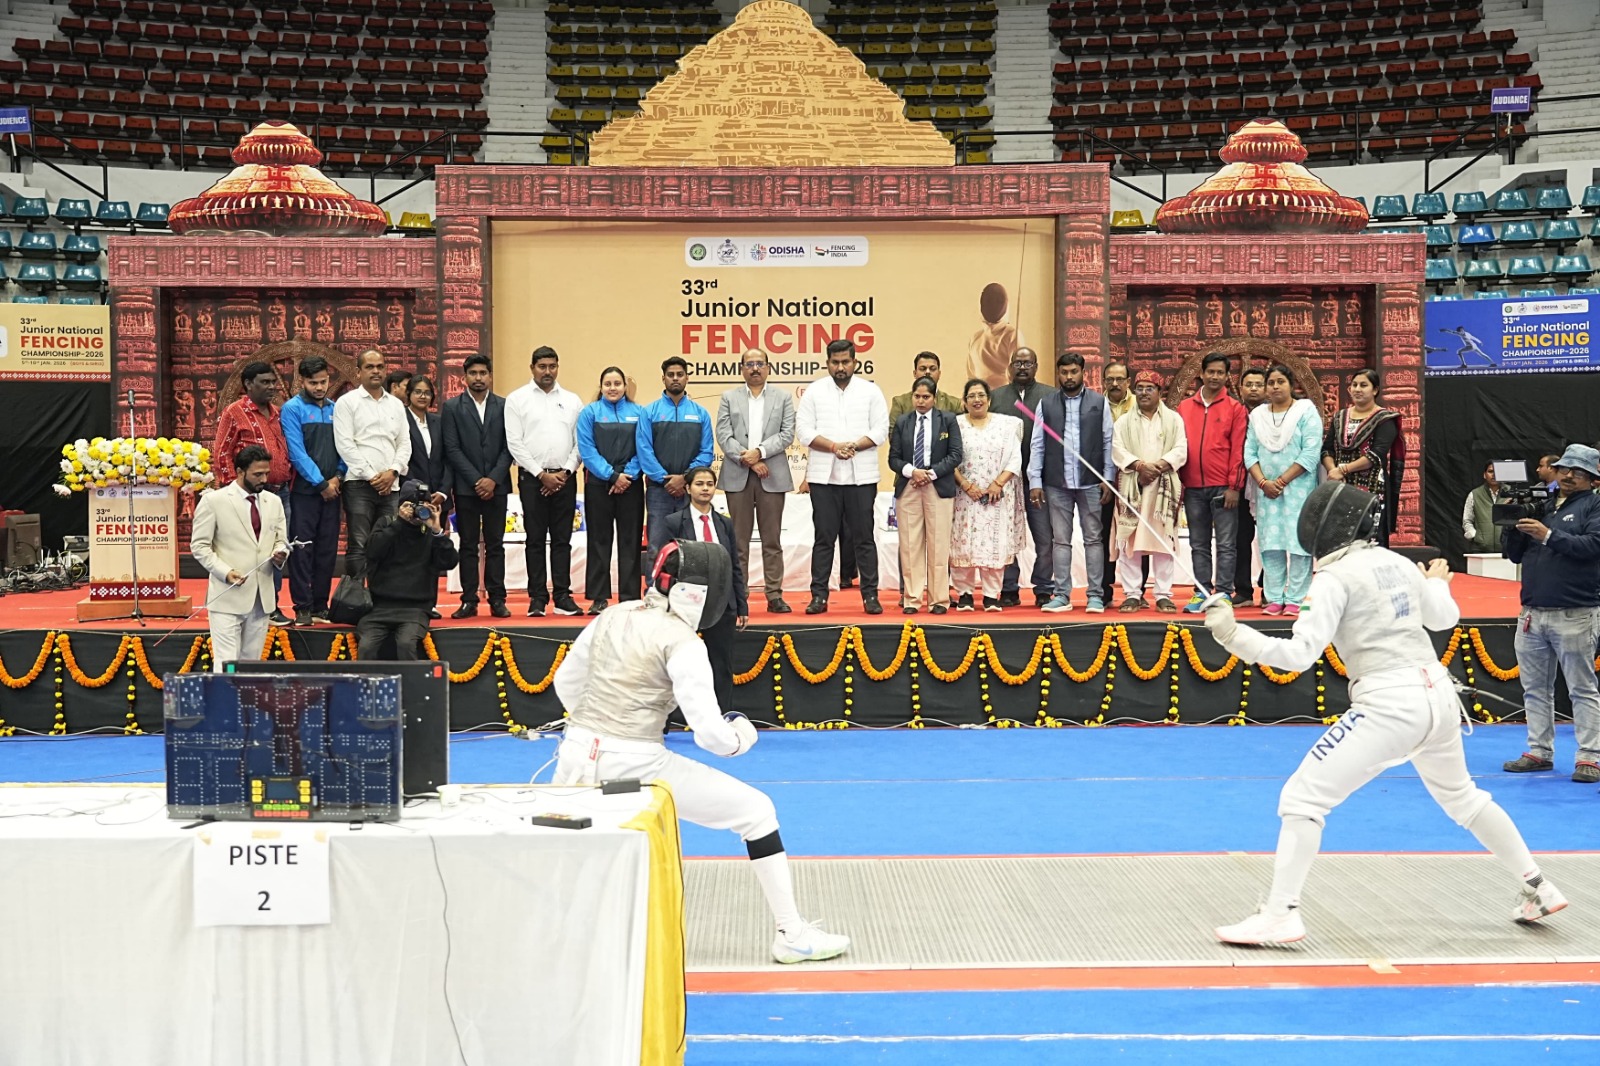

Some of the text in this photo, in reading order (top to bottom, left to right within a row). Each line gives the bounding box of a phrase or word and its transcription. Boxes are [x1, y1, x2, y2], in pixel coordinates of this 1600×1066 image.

[1493, 95, 1528, 105] AUDIANCE
[769, 246, 805, 255] ODISHA
[681, 279, 718, 296] 33rd
[681, 296, 874, 318] Junior National
[20, 325, 103, 335] Junior National
[1502, 321, 1590, 333] Junior National
[20, 336, 104, 349] FENCING
[681, 323, 875, 355] FENCING
[1502, 332, 1590, 348] FENCING
[20, 350, 104, 358] CHAMPIONSHIP-2026
[1502, 347, 1589, 357] CHAMPIONSHIP-2026
[96, 524, 169, 535] FENCING
[1311, 711, 1365, 761] INDIA
[229, 844, 298, 865] PISTE
[257, 890, 272, 911] 2
